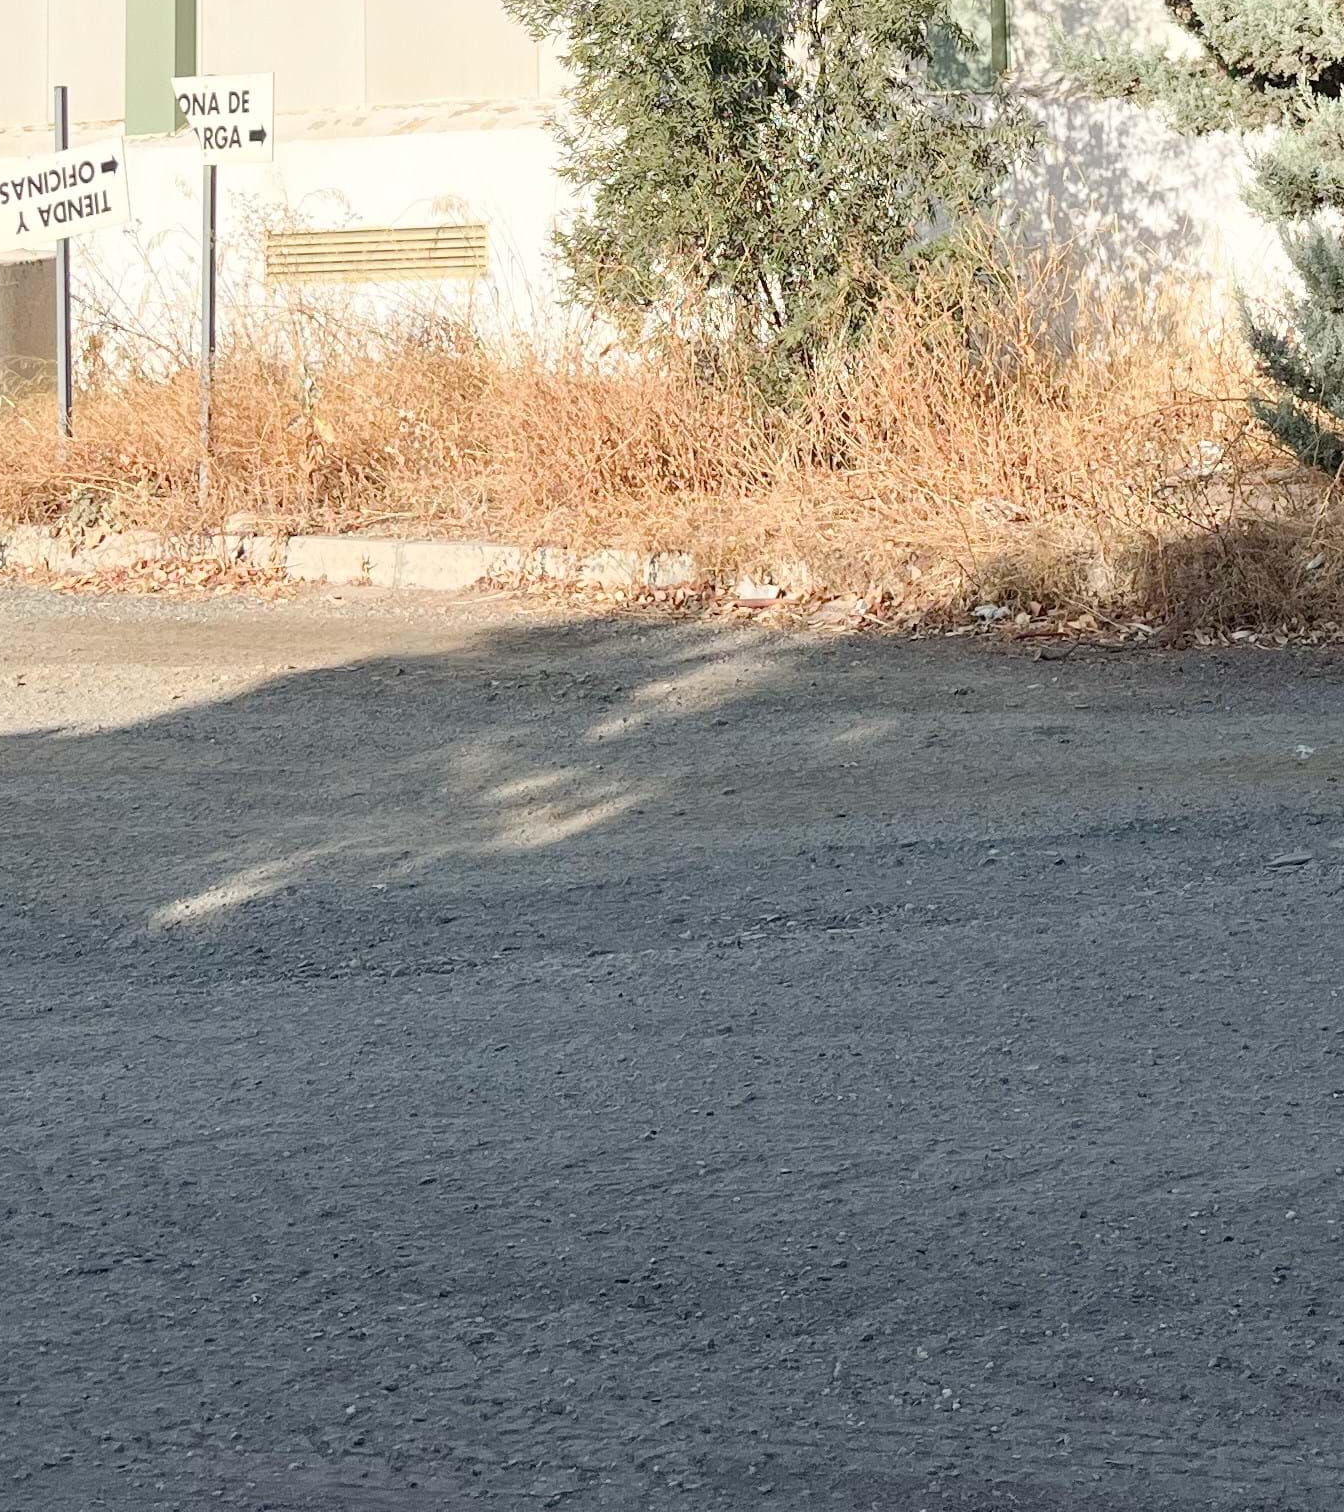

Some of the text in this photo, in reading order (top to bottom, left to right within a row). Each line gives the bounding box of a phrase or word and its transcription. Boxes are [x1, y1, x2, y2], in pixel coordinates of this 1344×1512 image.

[177, 90, 250, 116] ONA DE
[194, 125, 242, 150] RGA
[16, 189, 112, 235] TIENDA Y
